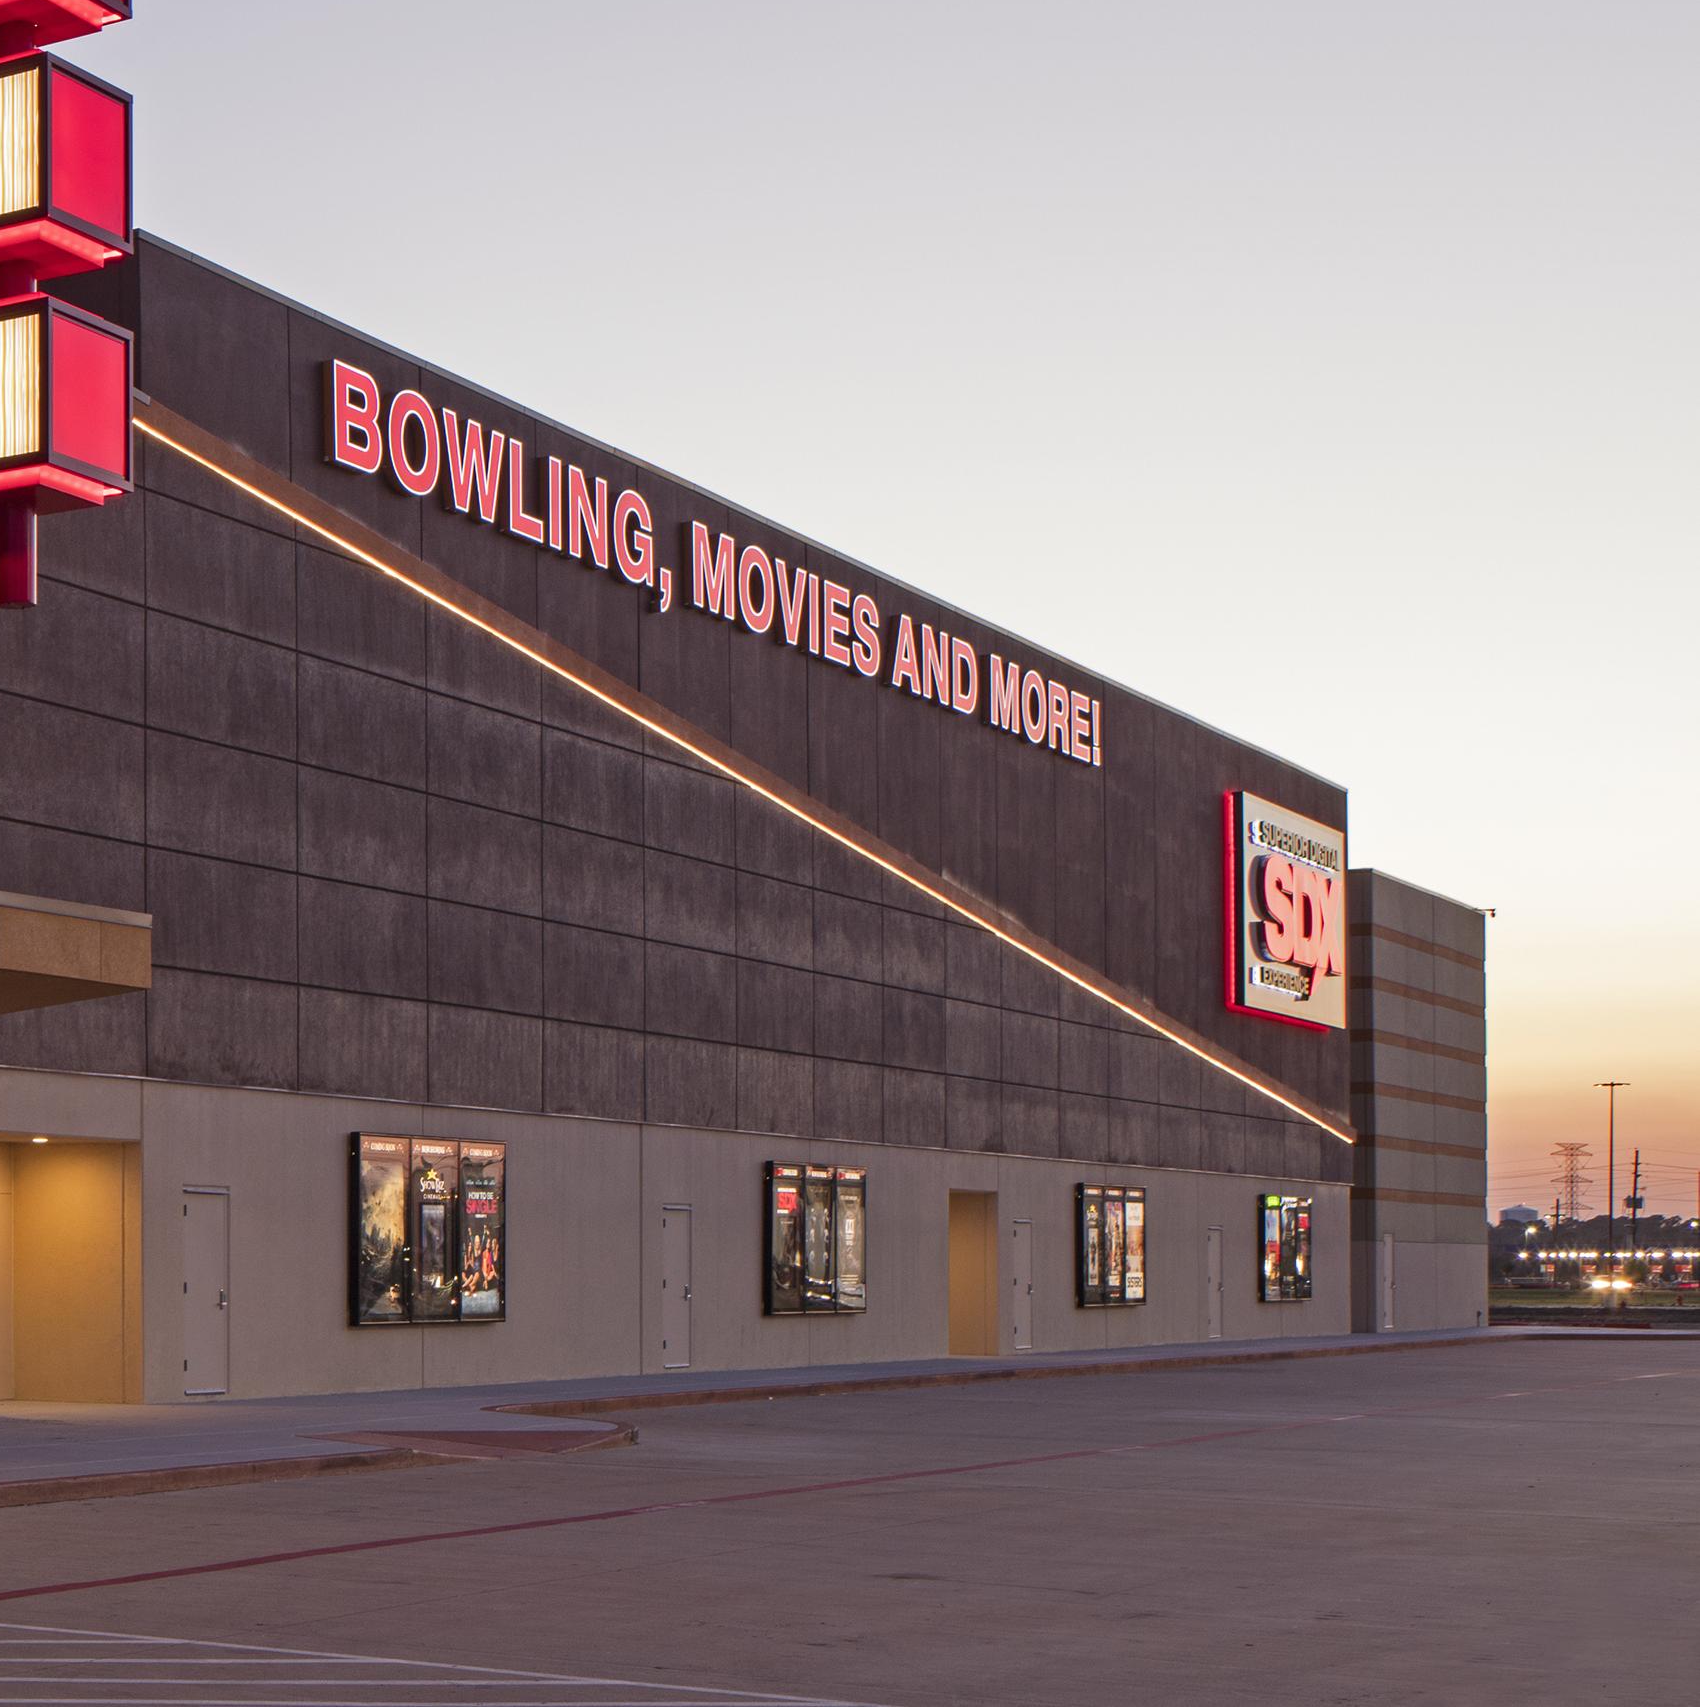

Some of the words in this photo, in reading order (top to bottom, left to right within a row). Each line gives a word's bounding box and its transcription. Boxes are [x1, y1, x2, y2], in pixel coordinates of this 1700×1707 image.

[333, 358, 672, 613] BOWLING,
[691, 520, 881, 678] MOVIES
[891, 613, 979, 715] AND
[989, 653, 1102, 767] MORE!
[1259, 820, 1307, 859] SUPERIOR
[1308, 839, 1340, 872] DIGITAL
[1261, 853, 1343, 976] SDX
[1260, 966, 1310, 996] EXPERIENCE
[465, 1199, 498, 1214] SINGLE
